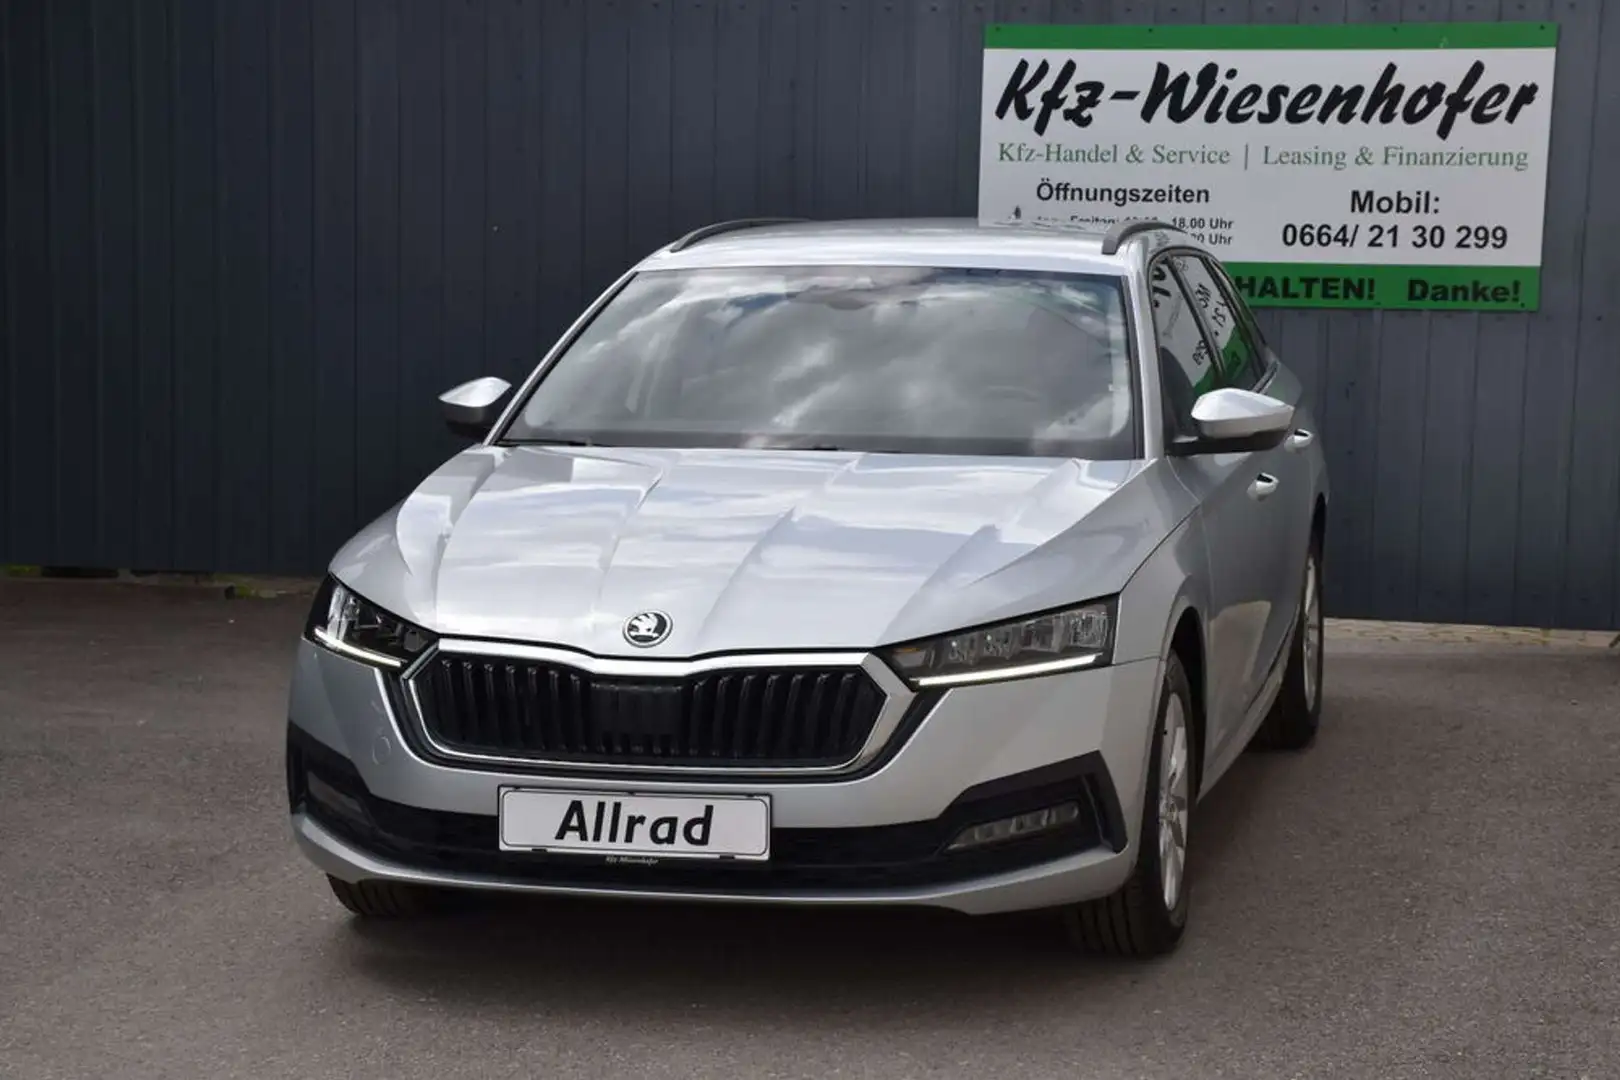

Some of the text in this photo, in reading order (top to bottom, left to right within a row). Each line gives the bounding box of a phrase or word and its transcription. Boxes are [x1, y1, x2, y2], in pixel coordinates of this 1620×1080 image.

[995, 58, 1539, 141] Kfz-Wiesenhofer
[999, 142, 1118, 164] Kfz-Handel
[1126, 144, 1145, 164] &
[1152, 144, 1231, 165] Service
[1262, 146, 1348, 171] Leasing
[1355, 147, 1374, 166] &
[1383, 146, 1529, 172] Finanzierung
[1036, 178, 1210, 207] Öffnungszeiten
[1350, 190, 1440, 214] Mobil:
[1210, 217, 1234, 229] Uhr
[1209, 233, 1233, 245] Uhr
[1282, 224, 1508, 249] 0664/ 21 30 299
[1408, 279, 1521, 303] Danke!
[555, 801, 714, 846] Allrad
